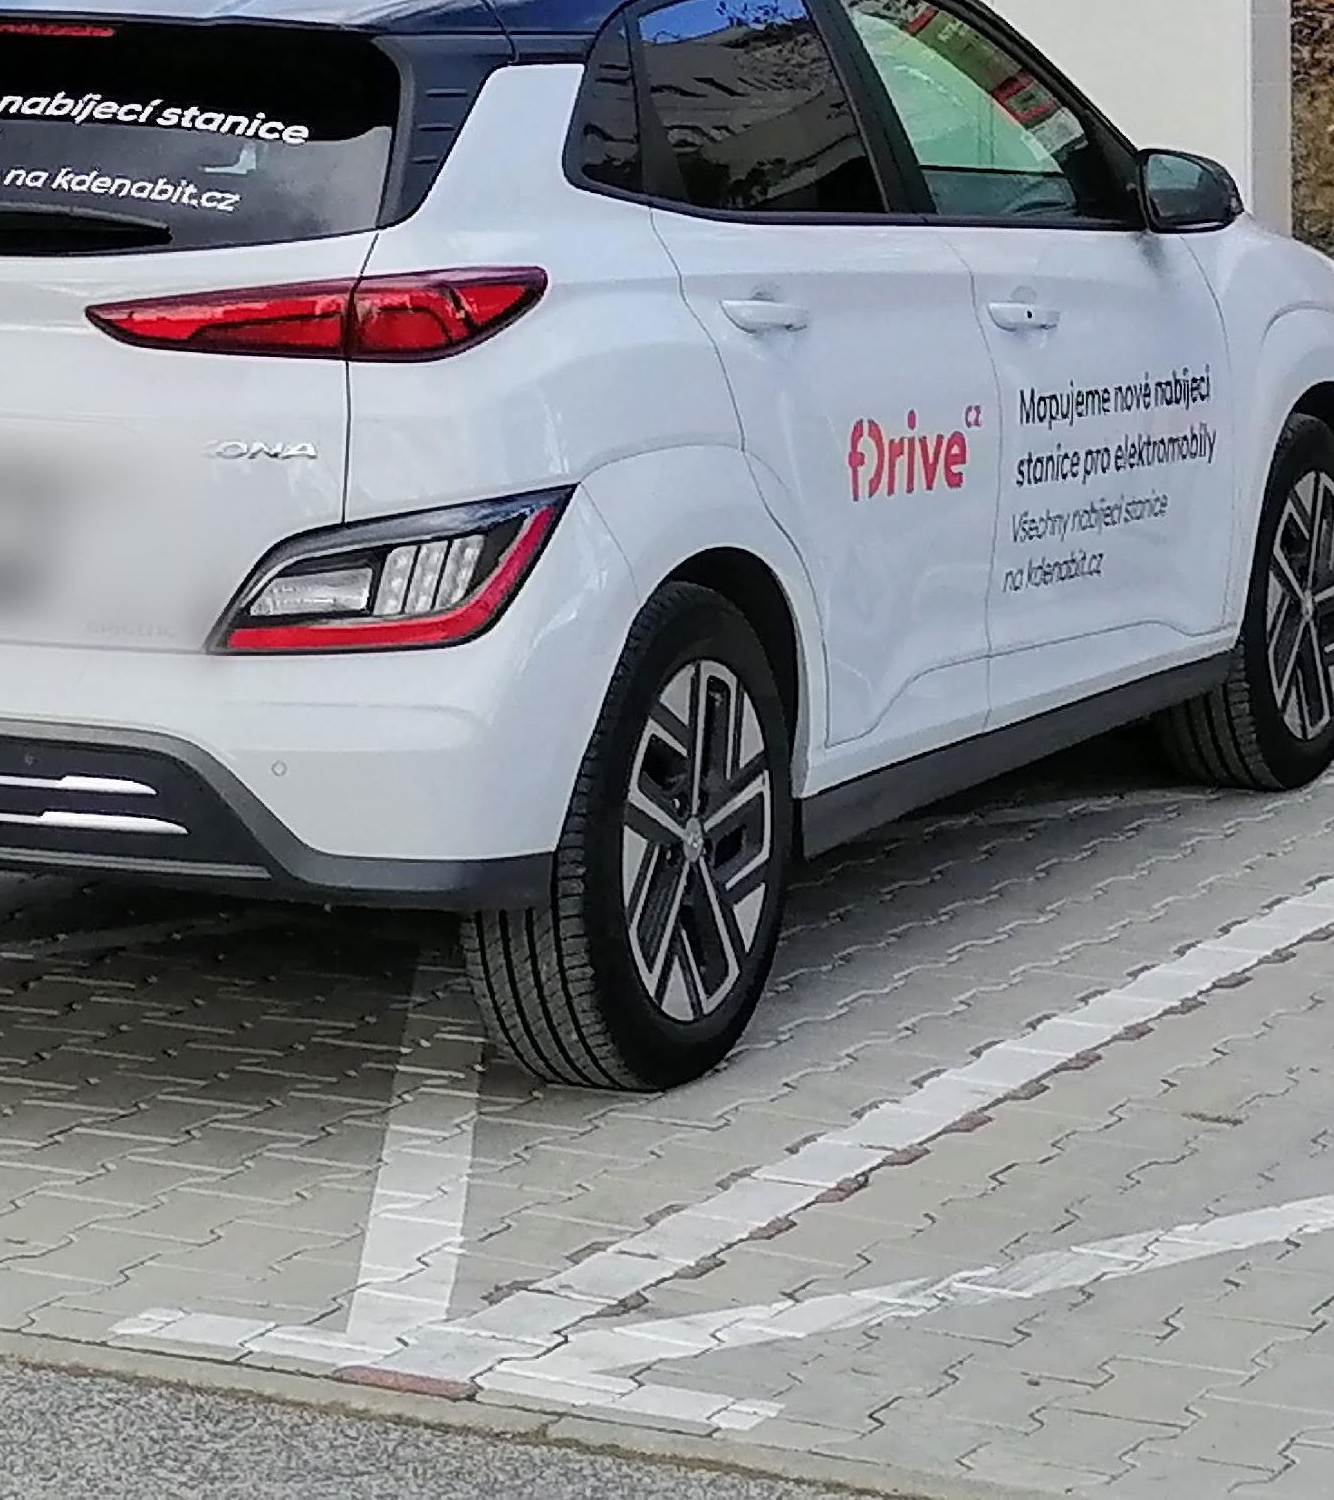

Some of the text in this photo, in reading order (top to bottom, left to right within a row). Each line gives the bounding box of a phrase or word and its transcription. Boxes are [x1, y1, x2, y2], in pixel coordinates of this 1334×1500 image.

[156, 106, 310, 144] stanice
[3, 167, 46, 188] na
[51, 167, 242, 212] kdenabit.cz
[1019, 380, 1111, 430] Mapujeme
[1113, 371, 1151, 412] nové
[1016, 421, 1217, 487] stanice pro elektromobily
[1003, 567, 1024, 593] na
